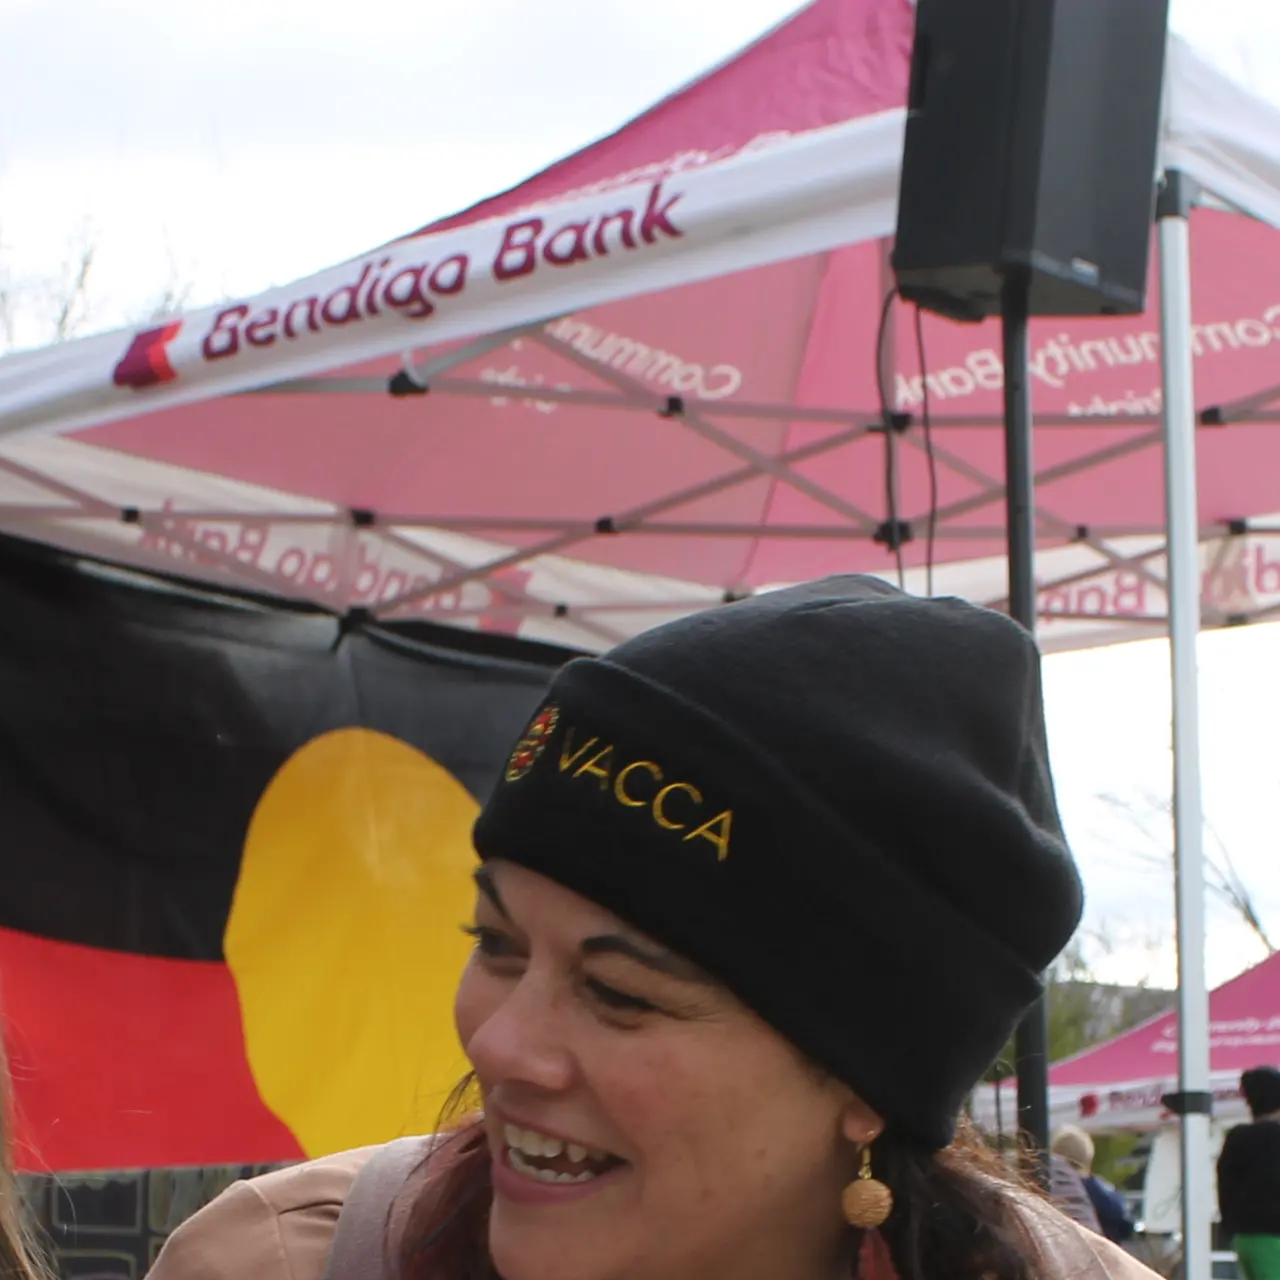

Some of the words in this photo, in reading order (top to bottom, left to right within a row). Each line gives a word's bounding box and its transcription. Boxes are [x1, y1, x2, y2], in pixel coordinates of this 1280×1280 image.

[202, 253, 468, 360] Bendigo
[492, 181, 683, 280] Bank
[557, 726, 733, 862] VACCA
